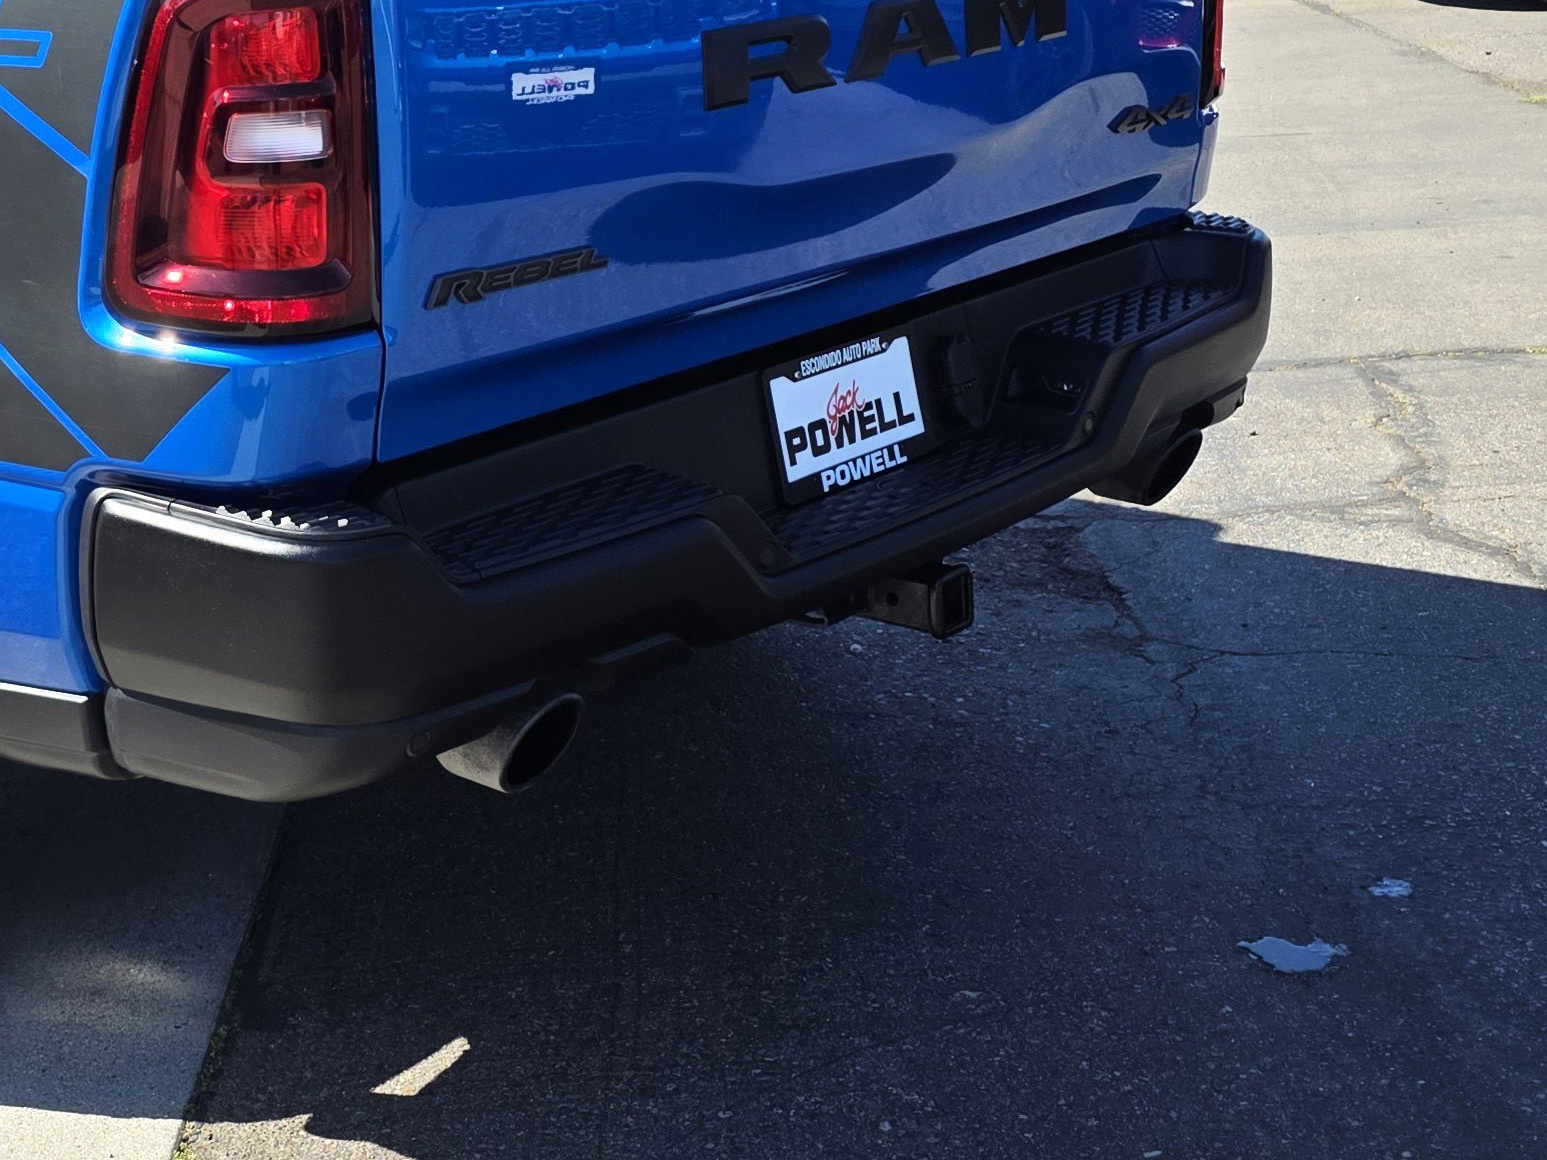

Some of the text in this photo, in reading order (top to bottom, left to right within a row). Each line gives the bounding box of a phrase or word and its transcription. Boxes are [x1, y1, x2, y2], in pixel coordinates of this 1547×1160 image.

[423, 245, 609, 310] REBEL
[800, 337, 882, 376] ESCONDIDO AUTO PARK
[784, 391, 916, 467] POWELL
[826, 379, 866, 438] Jack
[820, 444, 908, 493] POWELL
